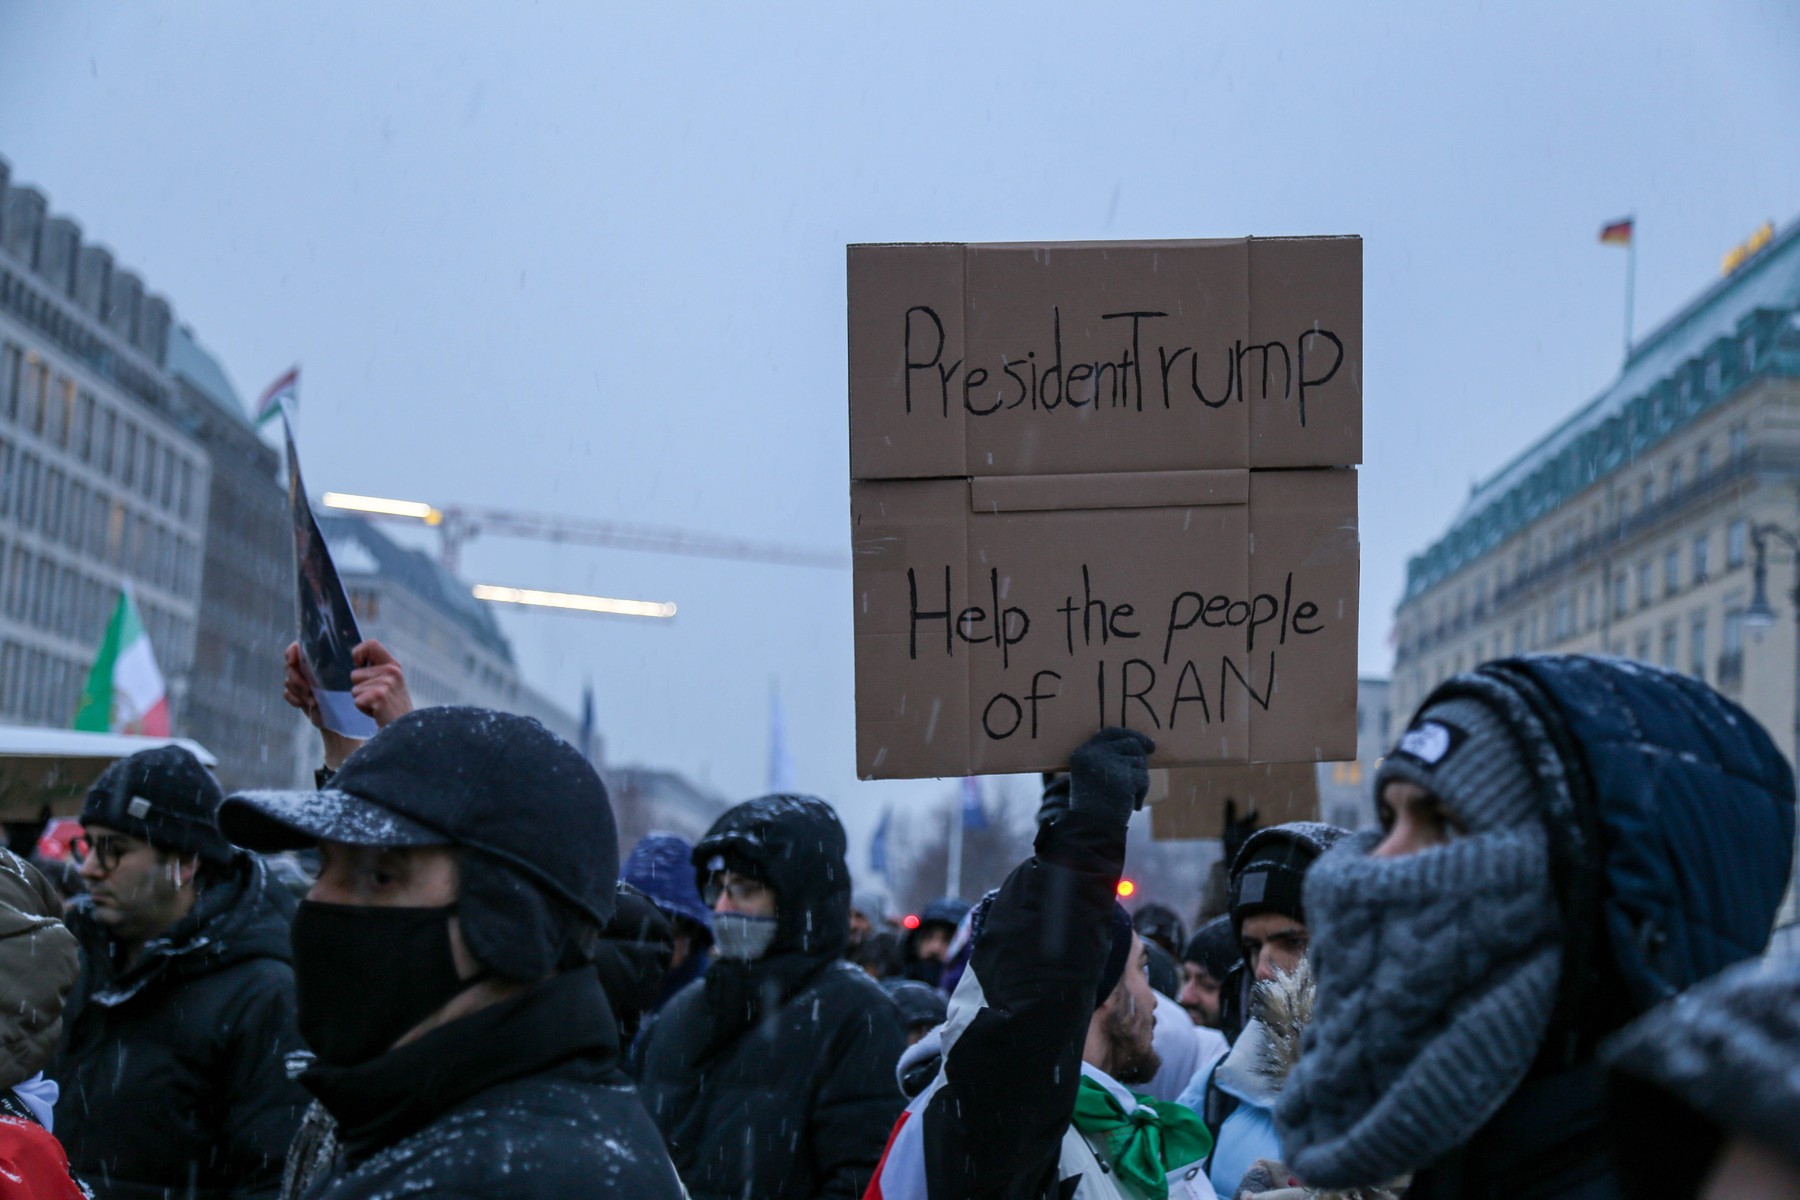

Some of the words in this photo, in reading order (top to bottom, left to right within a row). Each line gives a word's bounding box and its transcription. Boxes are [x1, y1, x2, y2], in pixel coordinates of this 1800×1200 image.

[906, 565, 1031, 669] Help
[1056, 564, 1141, 656] the
[1163, 571, 1325, 664] people
[982, 670, 1062, 740] of
[1098, 651, 1275, 729] IRAN
